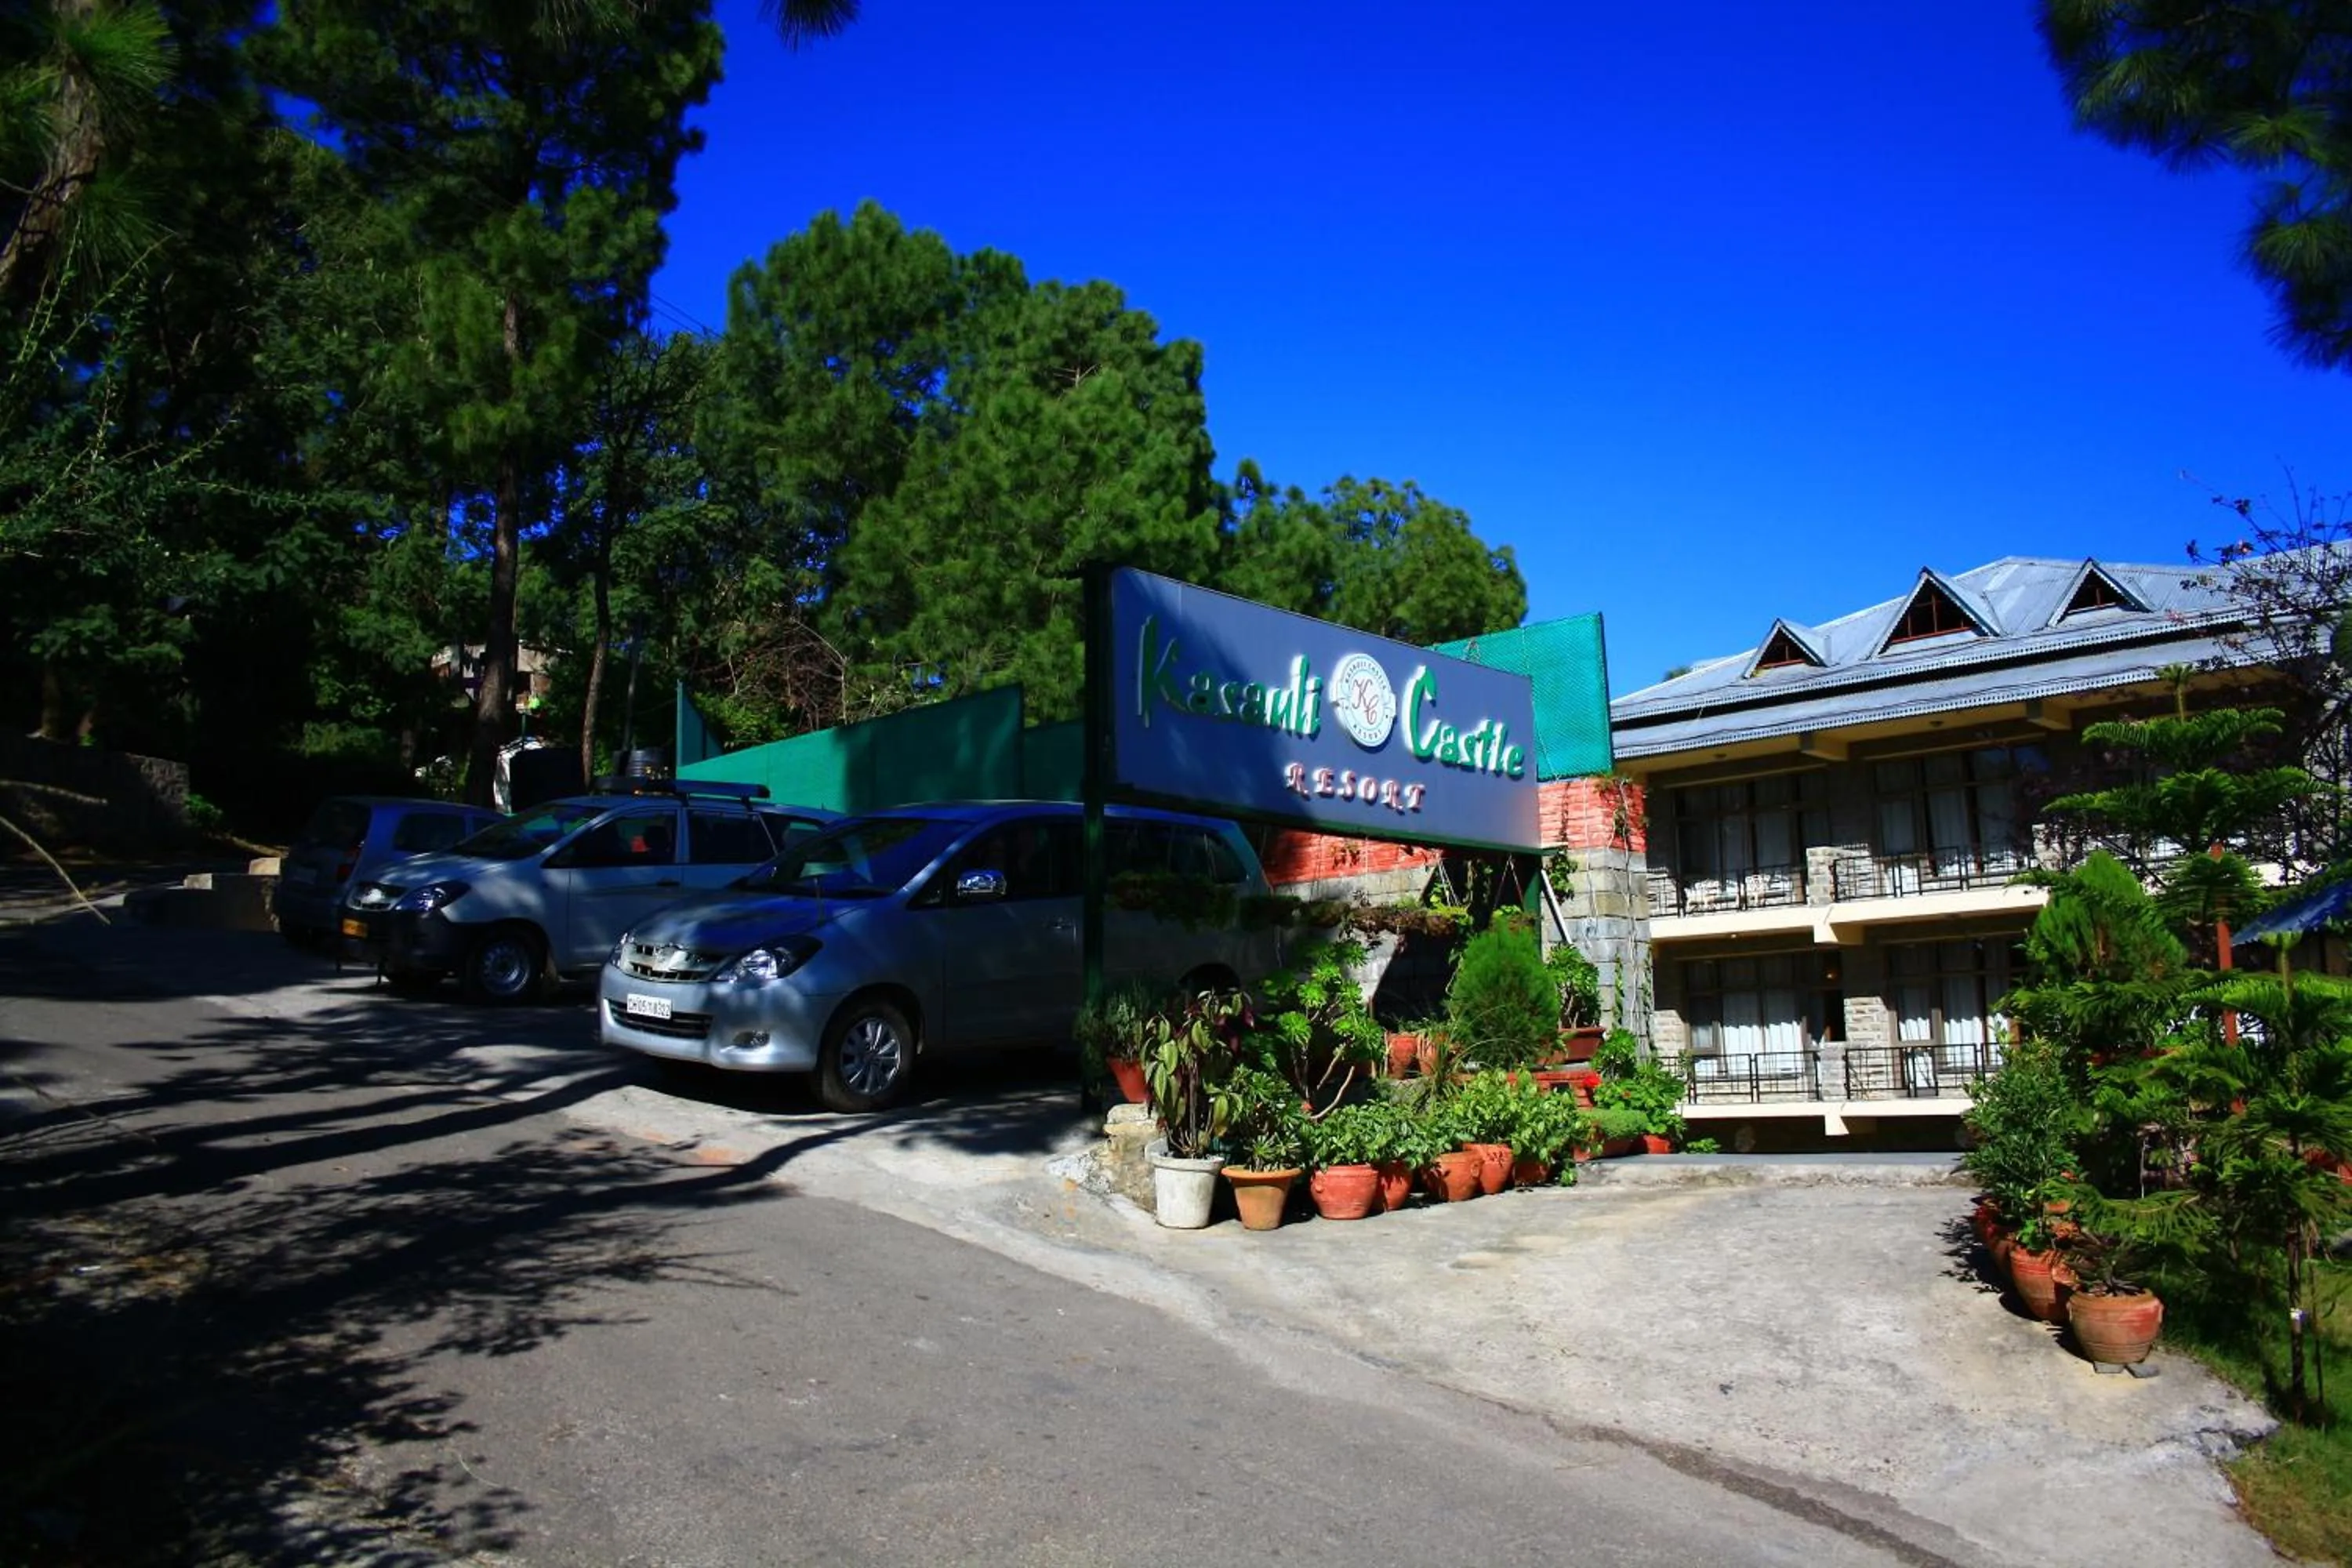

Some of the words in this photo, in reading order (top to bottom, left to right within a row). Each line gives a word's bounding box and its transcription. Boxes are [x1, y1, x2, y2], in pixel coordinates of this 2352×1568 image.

[1138, 615, 1323, 735] Kasauli
[1403, 666, 1525, 775] Castle
[1284, 763, 1425, 812] RESORT
